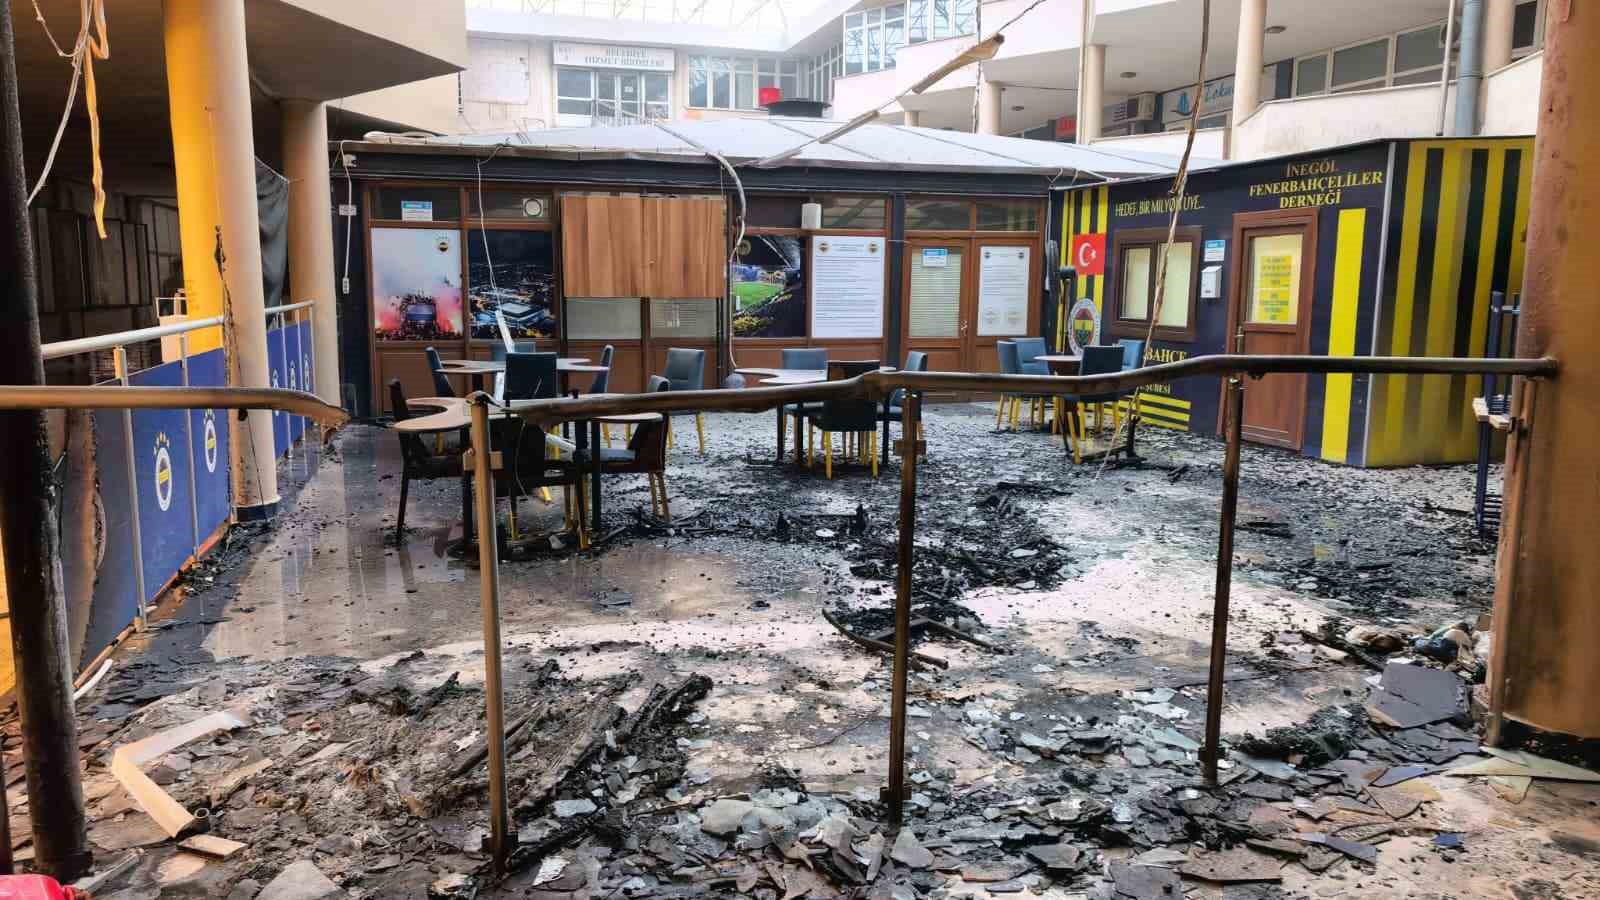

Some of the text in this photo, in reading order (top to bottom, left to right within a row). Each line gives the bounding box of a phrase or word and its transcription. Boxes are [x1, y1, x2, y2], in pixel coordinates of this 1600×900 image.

[1286, 158, 1338, 177] İNEGÖL
[1248, 171, 1384, 197] FENERBAHÇELİLER
[1279, 189, 1342, 209] DERNEĞİ
